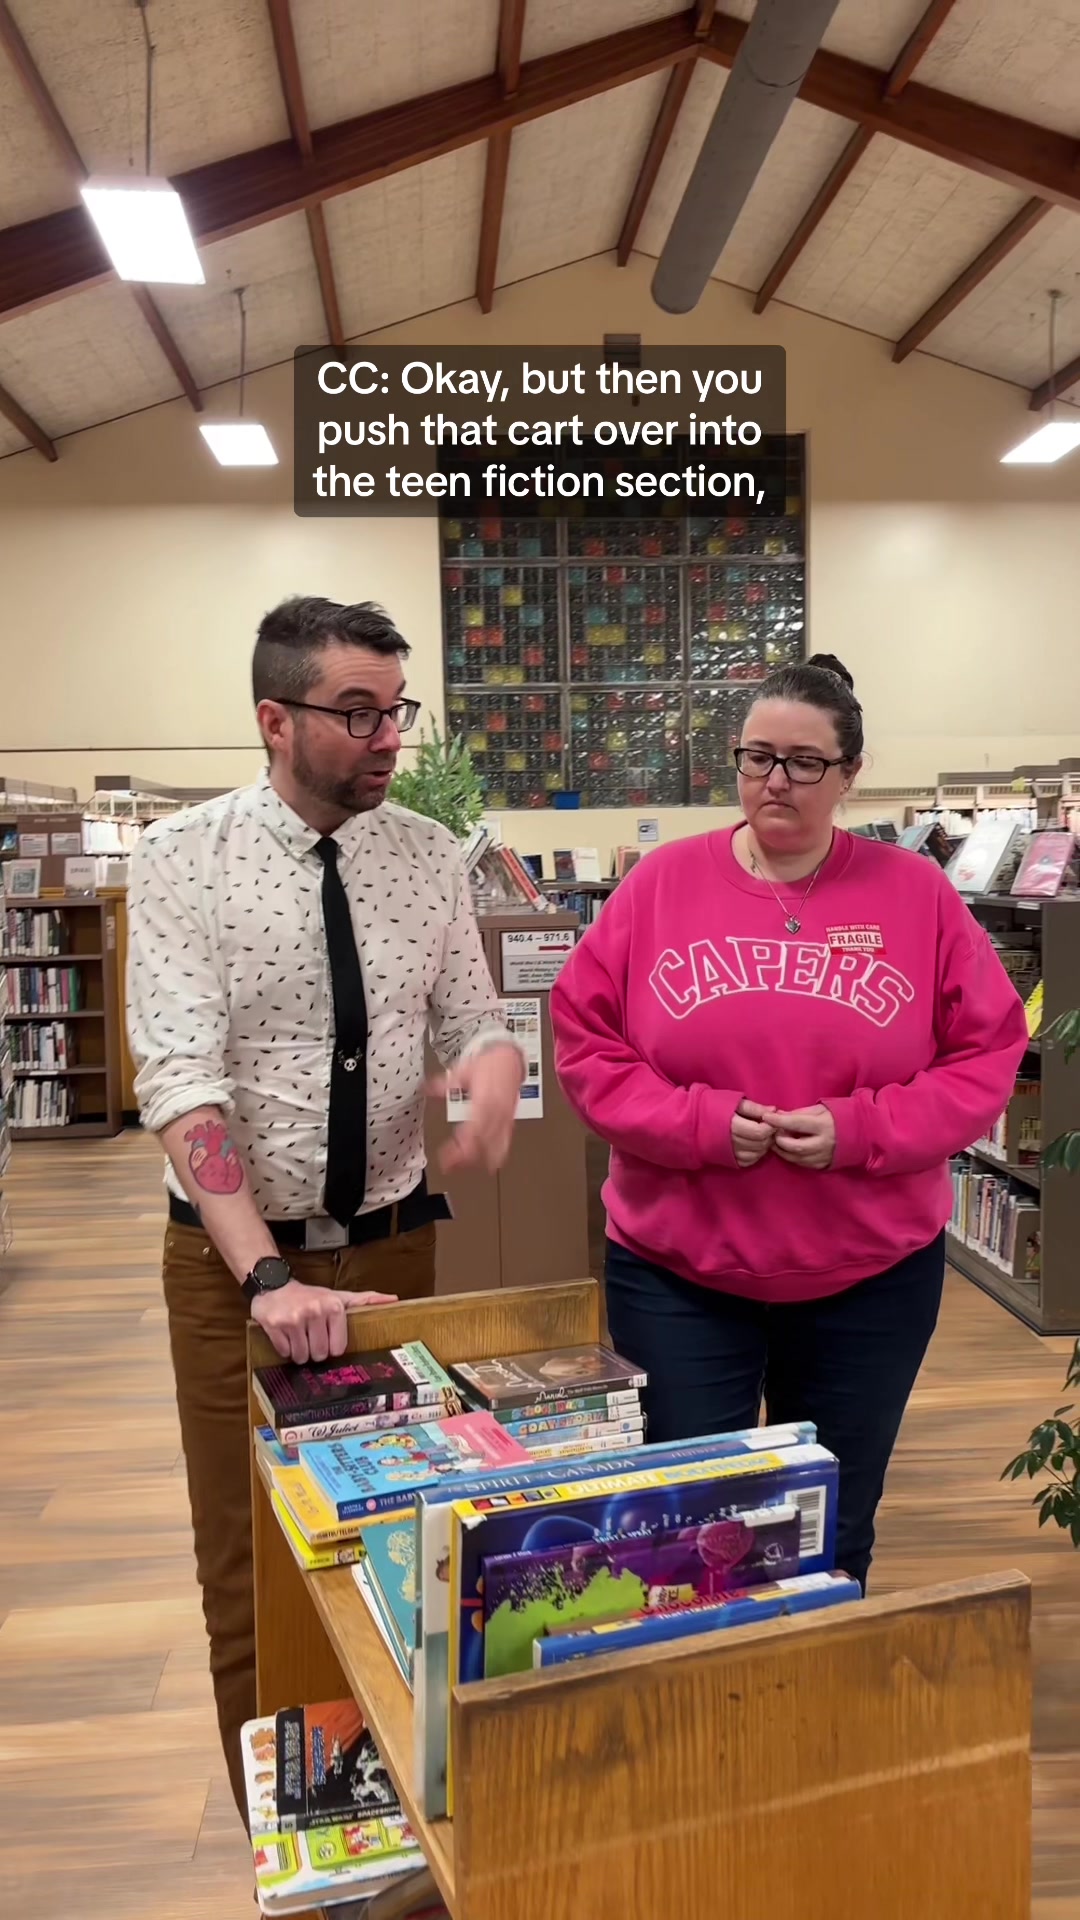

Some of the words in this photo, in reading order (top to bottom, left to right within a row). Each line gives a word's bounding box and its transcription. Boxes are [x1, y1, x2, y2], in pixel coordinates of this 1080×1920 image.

[507, 933, 533, 943] 940.4
[544, 932, 570, 941] 971.6
[829, 933, 882, 945] FRAGILE
[649, 936, 914, 1027] CAPERS
[326, 1421, 360, 1438] Juliet
[519, 1419, 557, 1436] GOAT
[464, 1474, 531, 1493] SPIRIT
[547, 1459, 636, 1480] CANADA
[566, 1471, 659, 1495] ULTIMATE
[379, 1494, 396, 1508] THE
[309, 1816, 331, 1827] STAR
[331, 1813, 354, 1822] WARS
